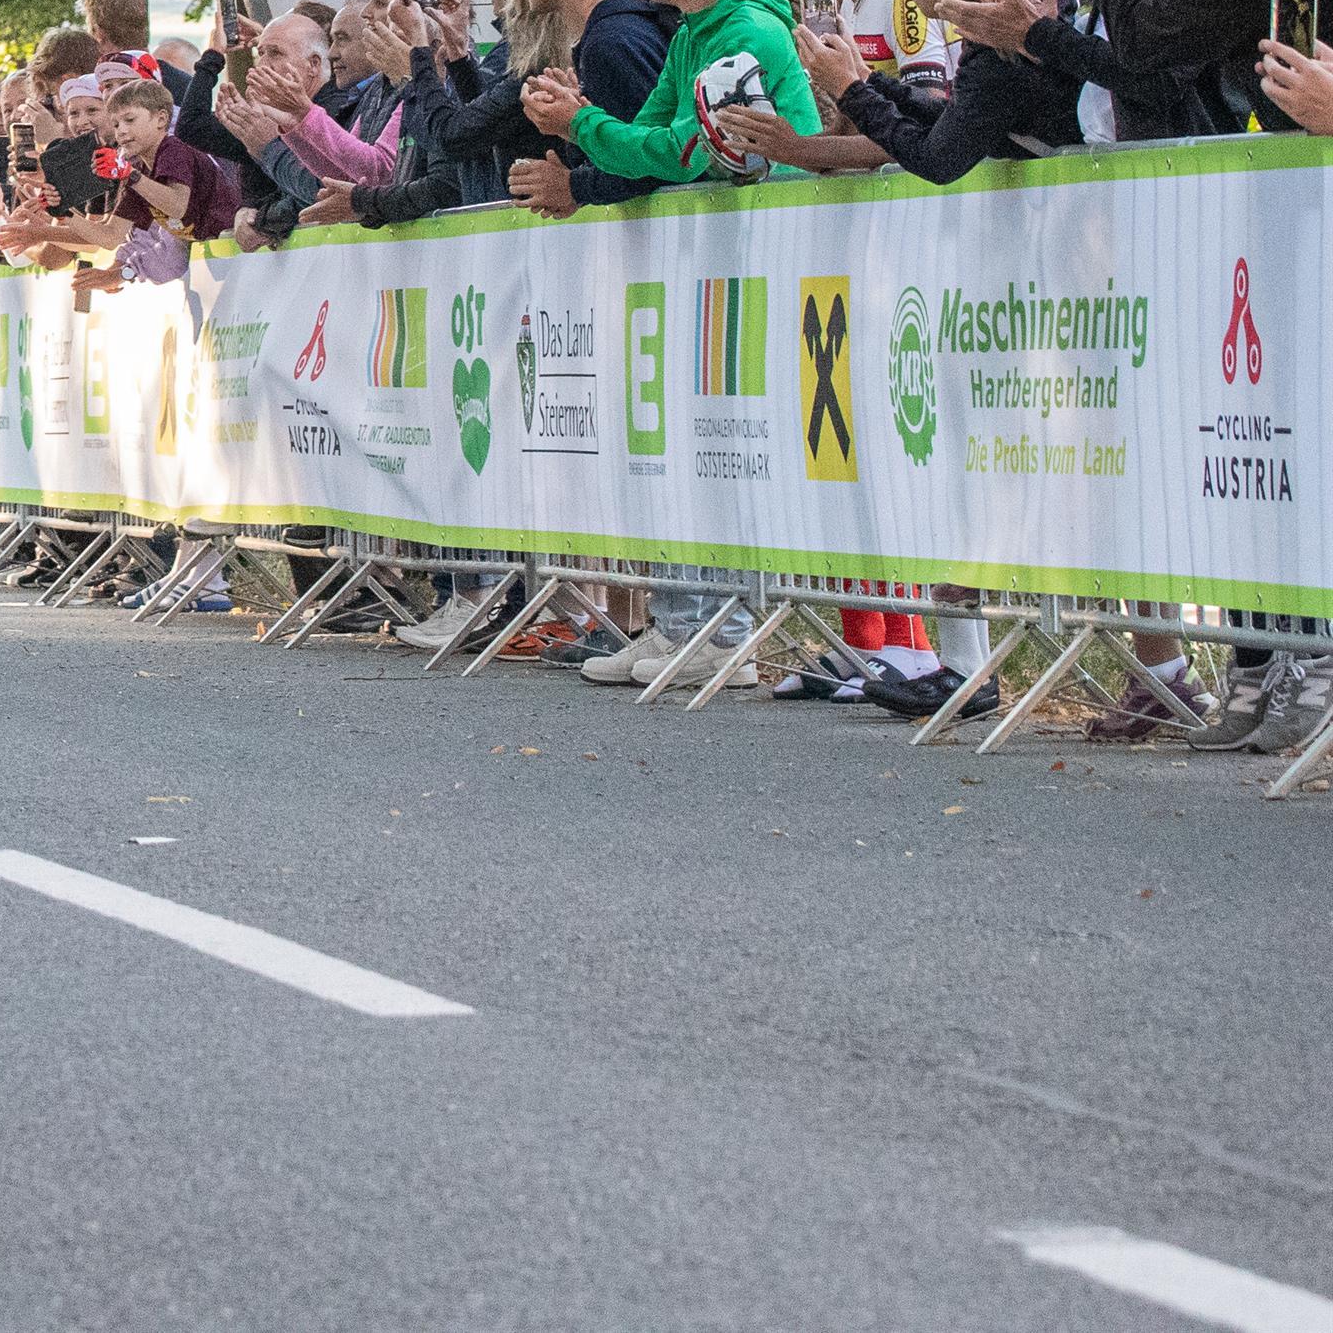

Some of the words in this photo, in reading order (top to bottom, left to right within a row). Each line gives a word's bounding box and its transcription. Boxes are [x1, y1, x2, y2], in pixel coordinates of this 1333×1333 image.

[451, 284, 486, 354] OST
[539, 309, 563, 358] Das
[566, 307, 594, 358] Land
[937, 277, 1149, 369] Maschinenring
[900, 349, 922, 396] MR
[970, 367, 1118, 418] Hartbergerland
[538, 392, 596, 439] Steiermark
[1217, 414, 1271, 442] CYCLING
[288, 425, 341, 456] AUSTRIA
[966, 435, 987, 475] Die
[993, 434, 1039, 476] Profis
[1044, 443, 1075, 475] vom
[1083, 436, 1126, 477] Land
[695, 450, 771, 481] OSTSTEIERMARK
[1202, 456, 1293, 503] AUSTRIA
